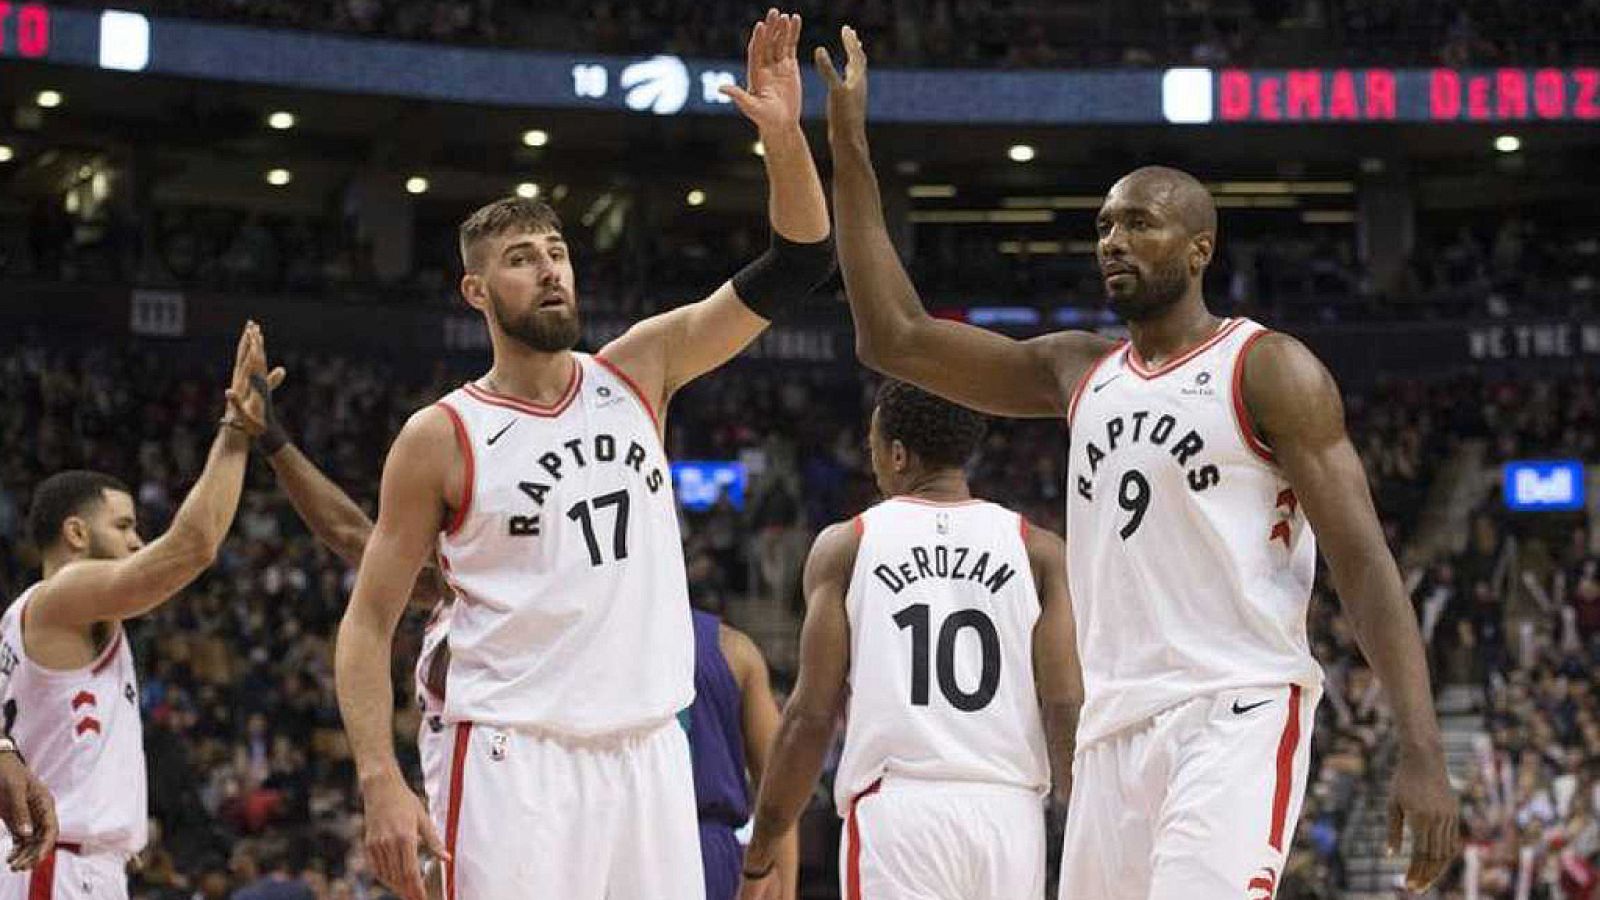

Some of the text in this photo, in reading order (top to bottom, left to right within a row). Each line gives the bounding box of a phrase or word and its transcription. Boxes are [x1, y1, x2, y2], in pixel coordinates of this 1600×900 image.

[509, 434, 664, 536] RAPTORS
[1078, 411, 1220, 501] RAPTORS
[566, 489, 630, 567] 17
[1119, 470, 1150, 541] 9
[892, 603, 1001, 712] 10
